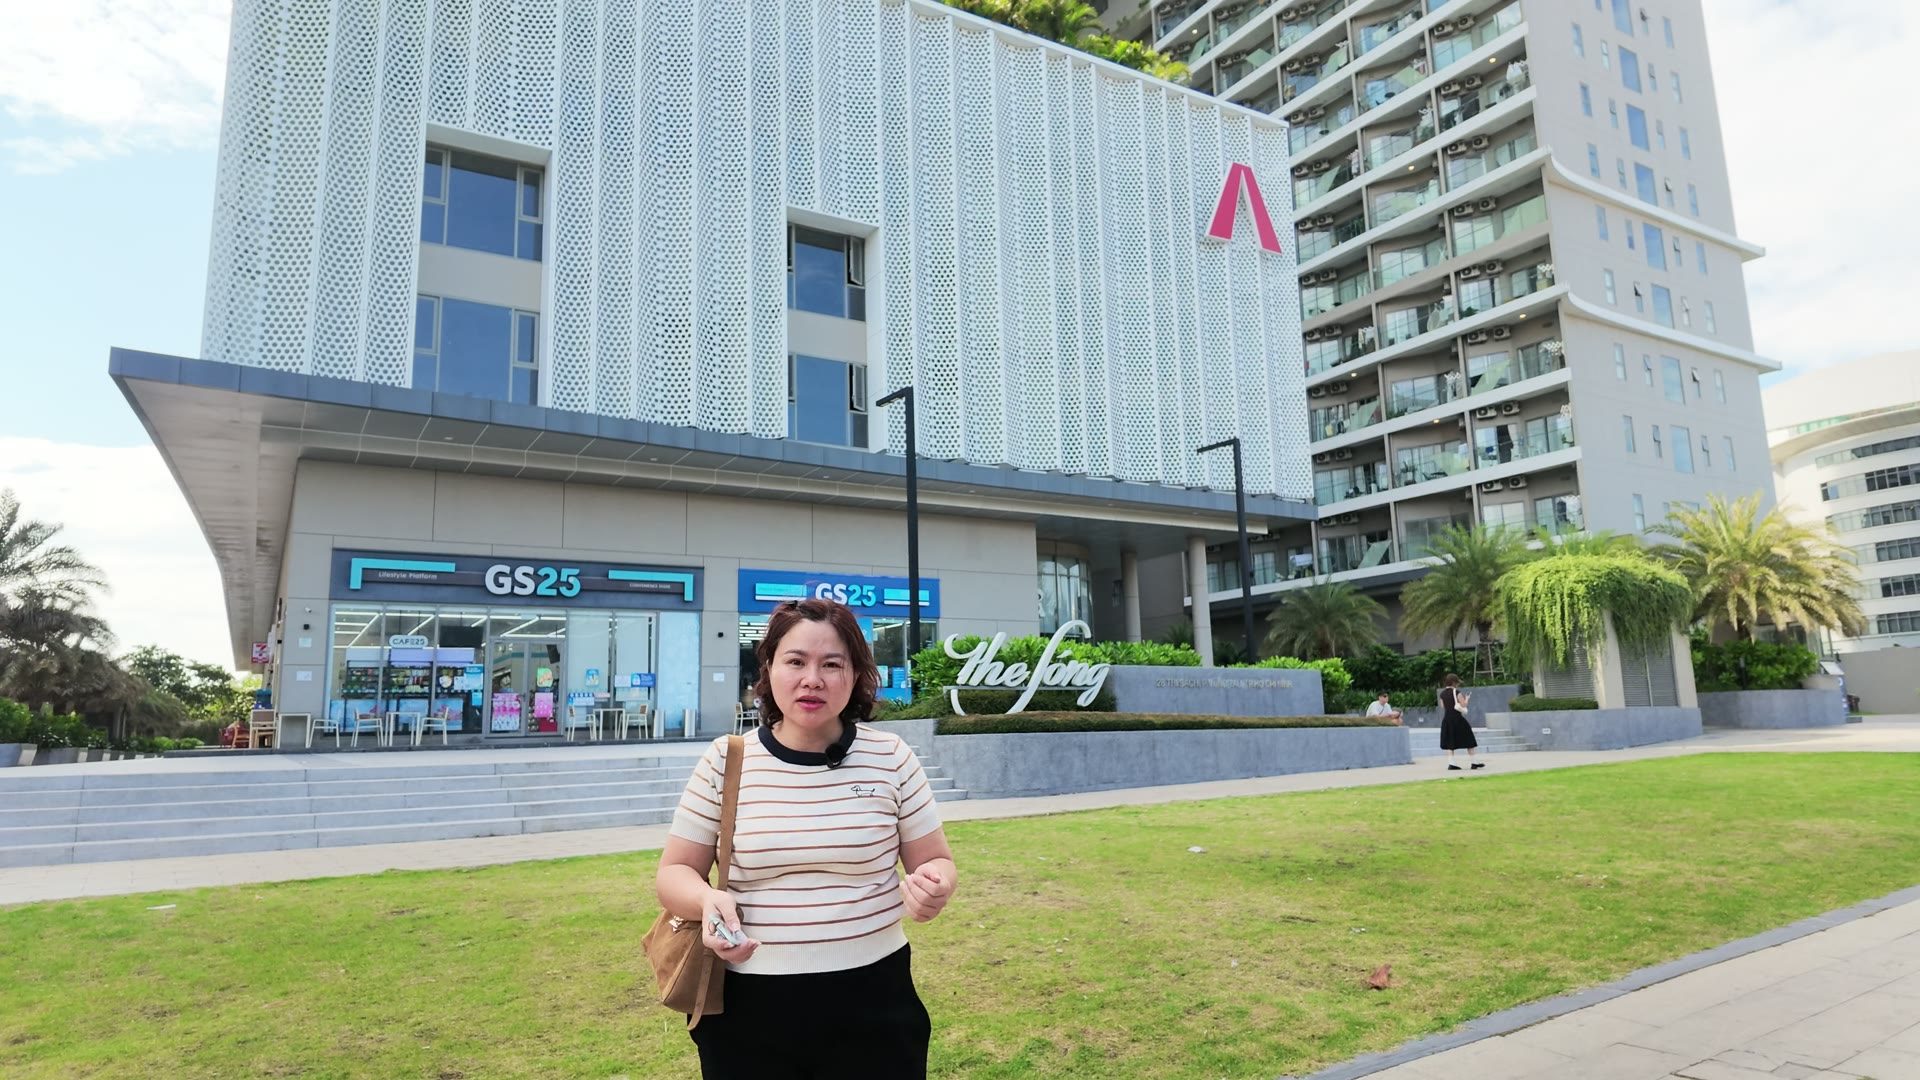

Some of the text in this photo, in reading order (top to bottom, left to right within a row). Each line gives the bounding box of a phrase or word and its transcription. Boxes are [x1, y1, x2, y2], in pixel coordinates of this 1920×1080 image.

[378, 571, 438, 581] Lifestyle Platform
[485, 564, 581, 598] GS25
[815, 583, 877, 607] GS25
